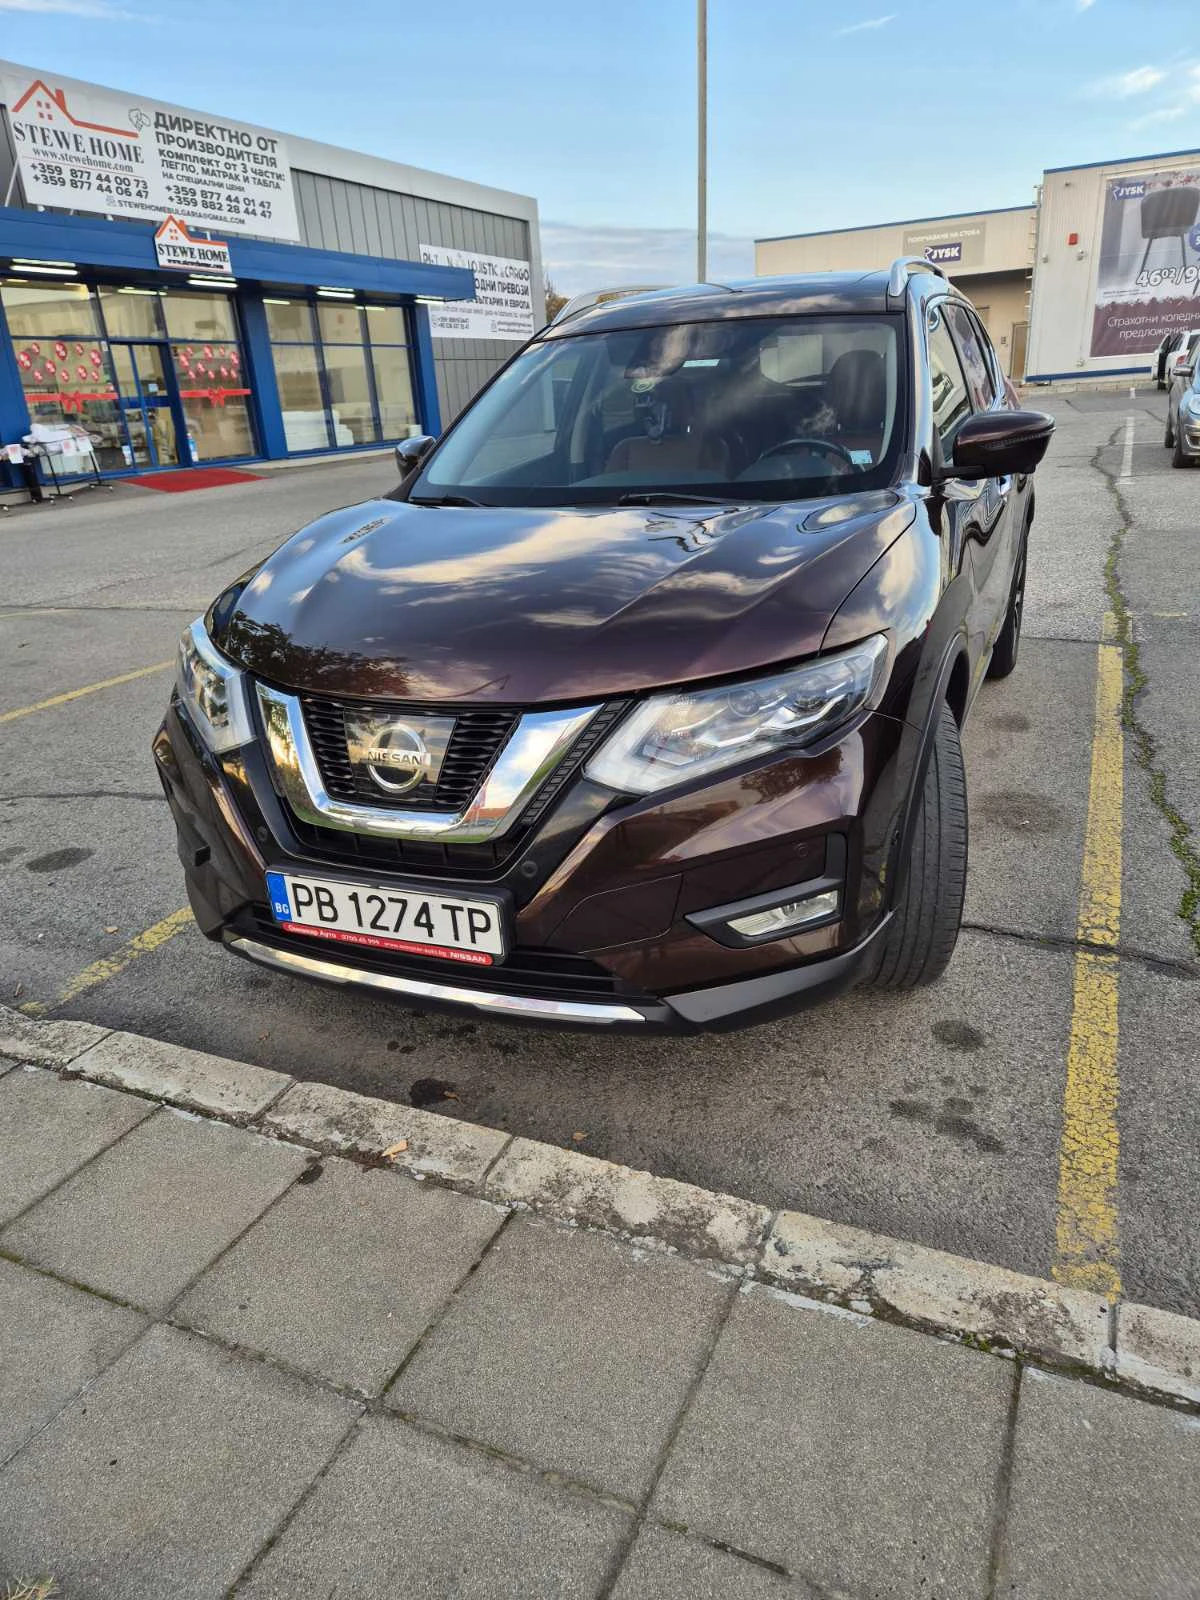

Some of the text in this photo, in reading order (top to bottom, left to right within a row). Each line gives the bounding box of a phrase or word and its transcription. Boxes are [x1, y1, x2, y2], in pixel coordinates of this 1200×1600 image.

[12, 121, 145, 164] STEWE HOME
[153, 111, 278, 153] ДИРЕКТНО ОТ
[32, 147, 134, 173] www.stewehome.com
[154, 131, 278, 168] ПРОИЗВОДИТЕЛЯ
[30, 163, 148, 189] +359 877 44 00 73
[158, 148, 285, 182] комплект от 3 части:
[33, 174, 149, 199] +359 877 44 06 47
[201, 167, 240, 182] МАТРАК
[242, 175, 250, 184] И
[252, 177, 281, 190] ТАБЛА
[1119, 185, 1145, 197] JYSK
[165, 184, 272, 210] +359 877 44 01 47
[168, 195, 272, 220] +359 882 28 44 47
[158, 243, 229, 263] STEWE HOME
[931, 246, 961, 260] JYSK
[498, 281, 530, 296] ПРЕВОЗИ
[1107, 315, 1159, 328] Страхотни
[367, 751, 423, 766] NISSAN
[275, 883, 492, 944] BG PB 1274 TP
[450, 951, 487, 963] NISSAN
